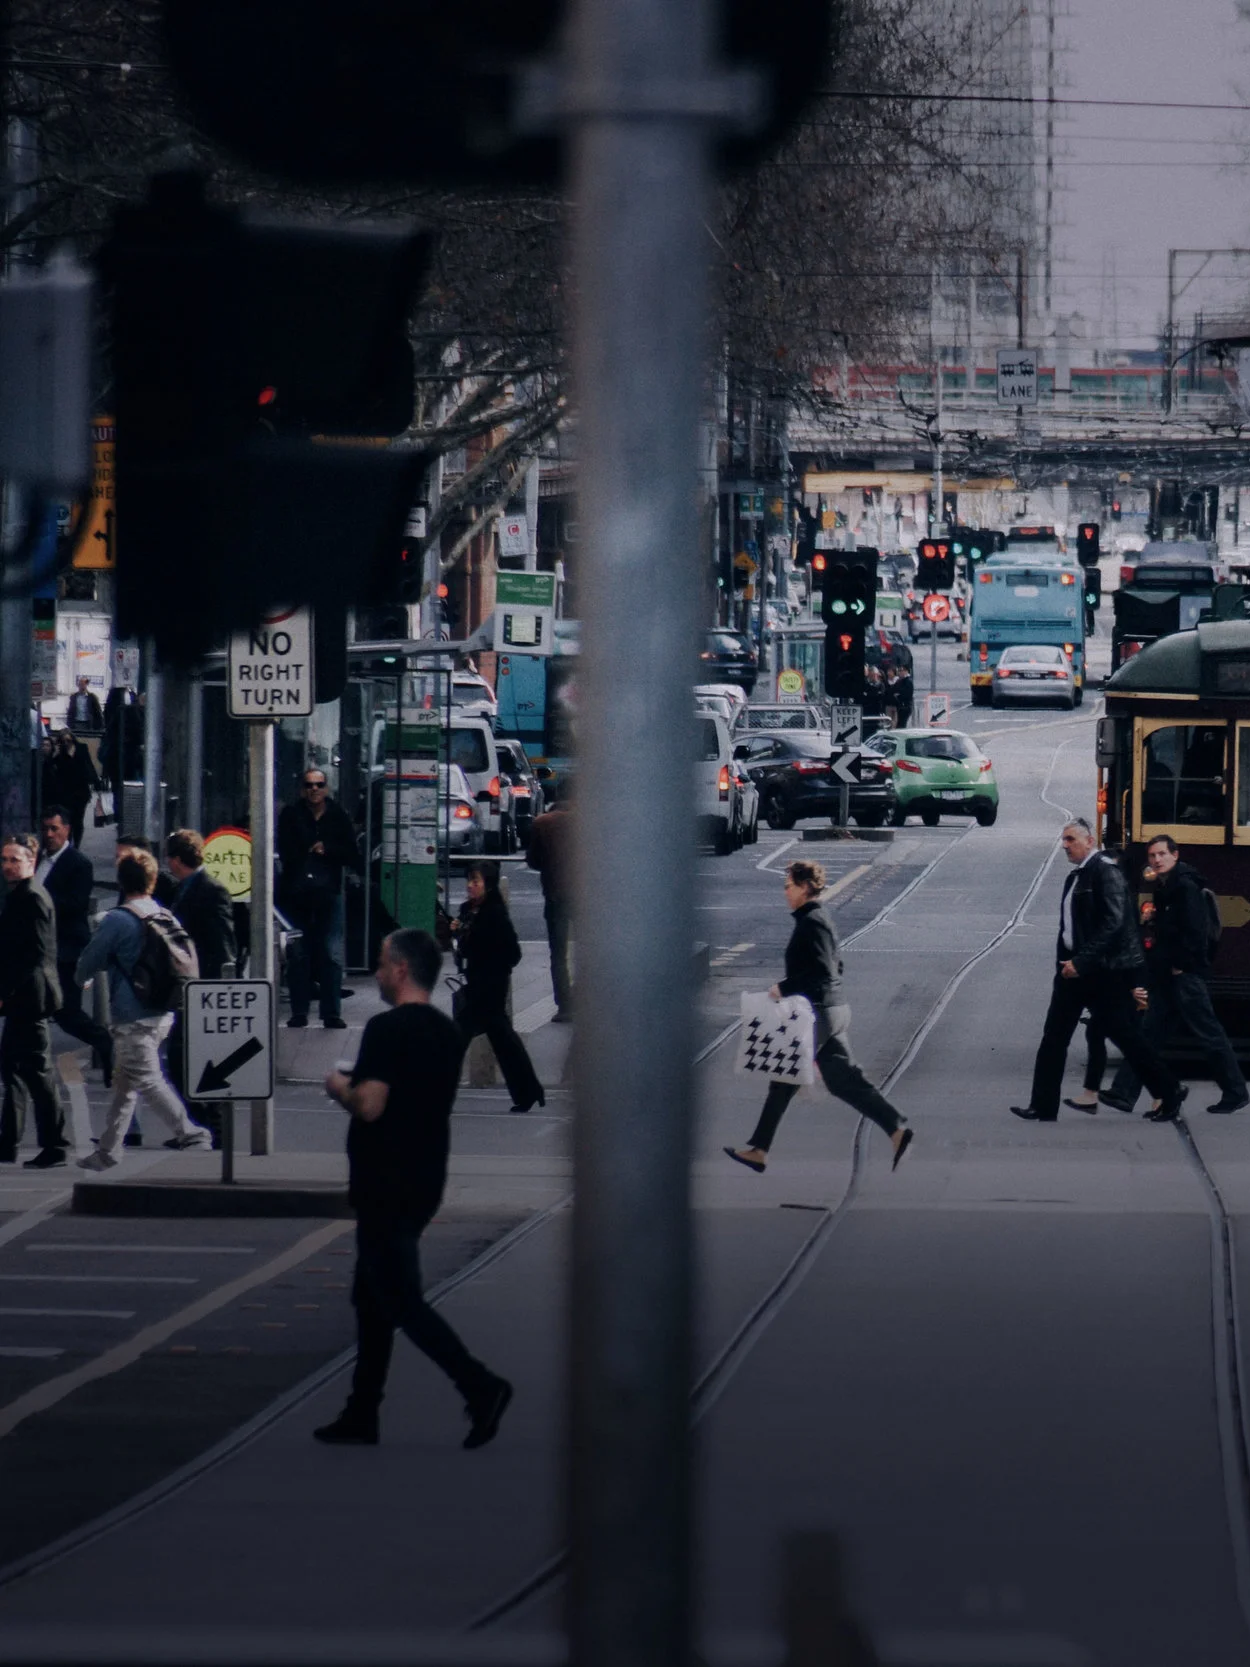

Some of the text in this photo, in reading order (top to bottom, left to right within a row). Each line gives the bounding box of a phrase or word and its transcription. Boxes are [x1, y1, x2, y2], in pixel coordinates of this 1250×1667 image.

[1002, 386, 1033, 398] LANE
[250, 630, 292, 656] NO
[239, 664, 304, 681] RIGHT
[241, 689, 301, 705] TURN
[212, 870, 246, 883] ZNE
[201, 992, 257, 1009] KEEP
[203, 1016, 255, 1034] LEFT
